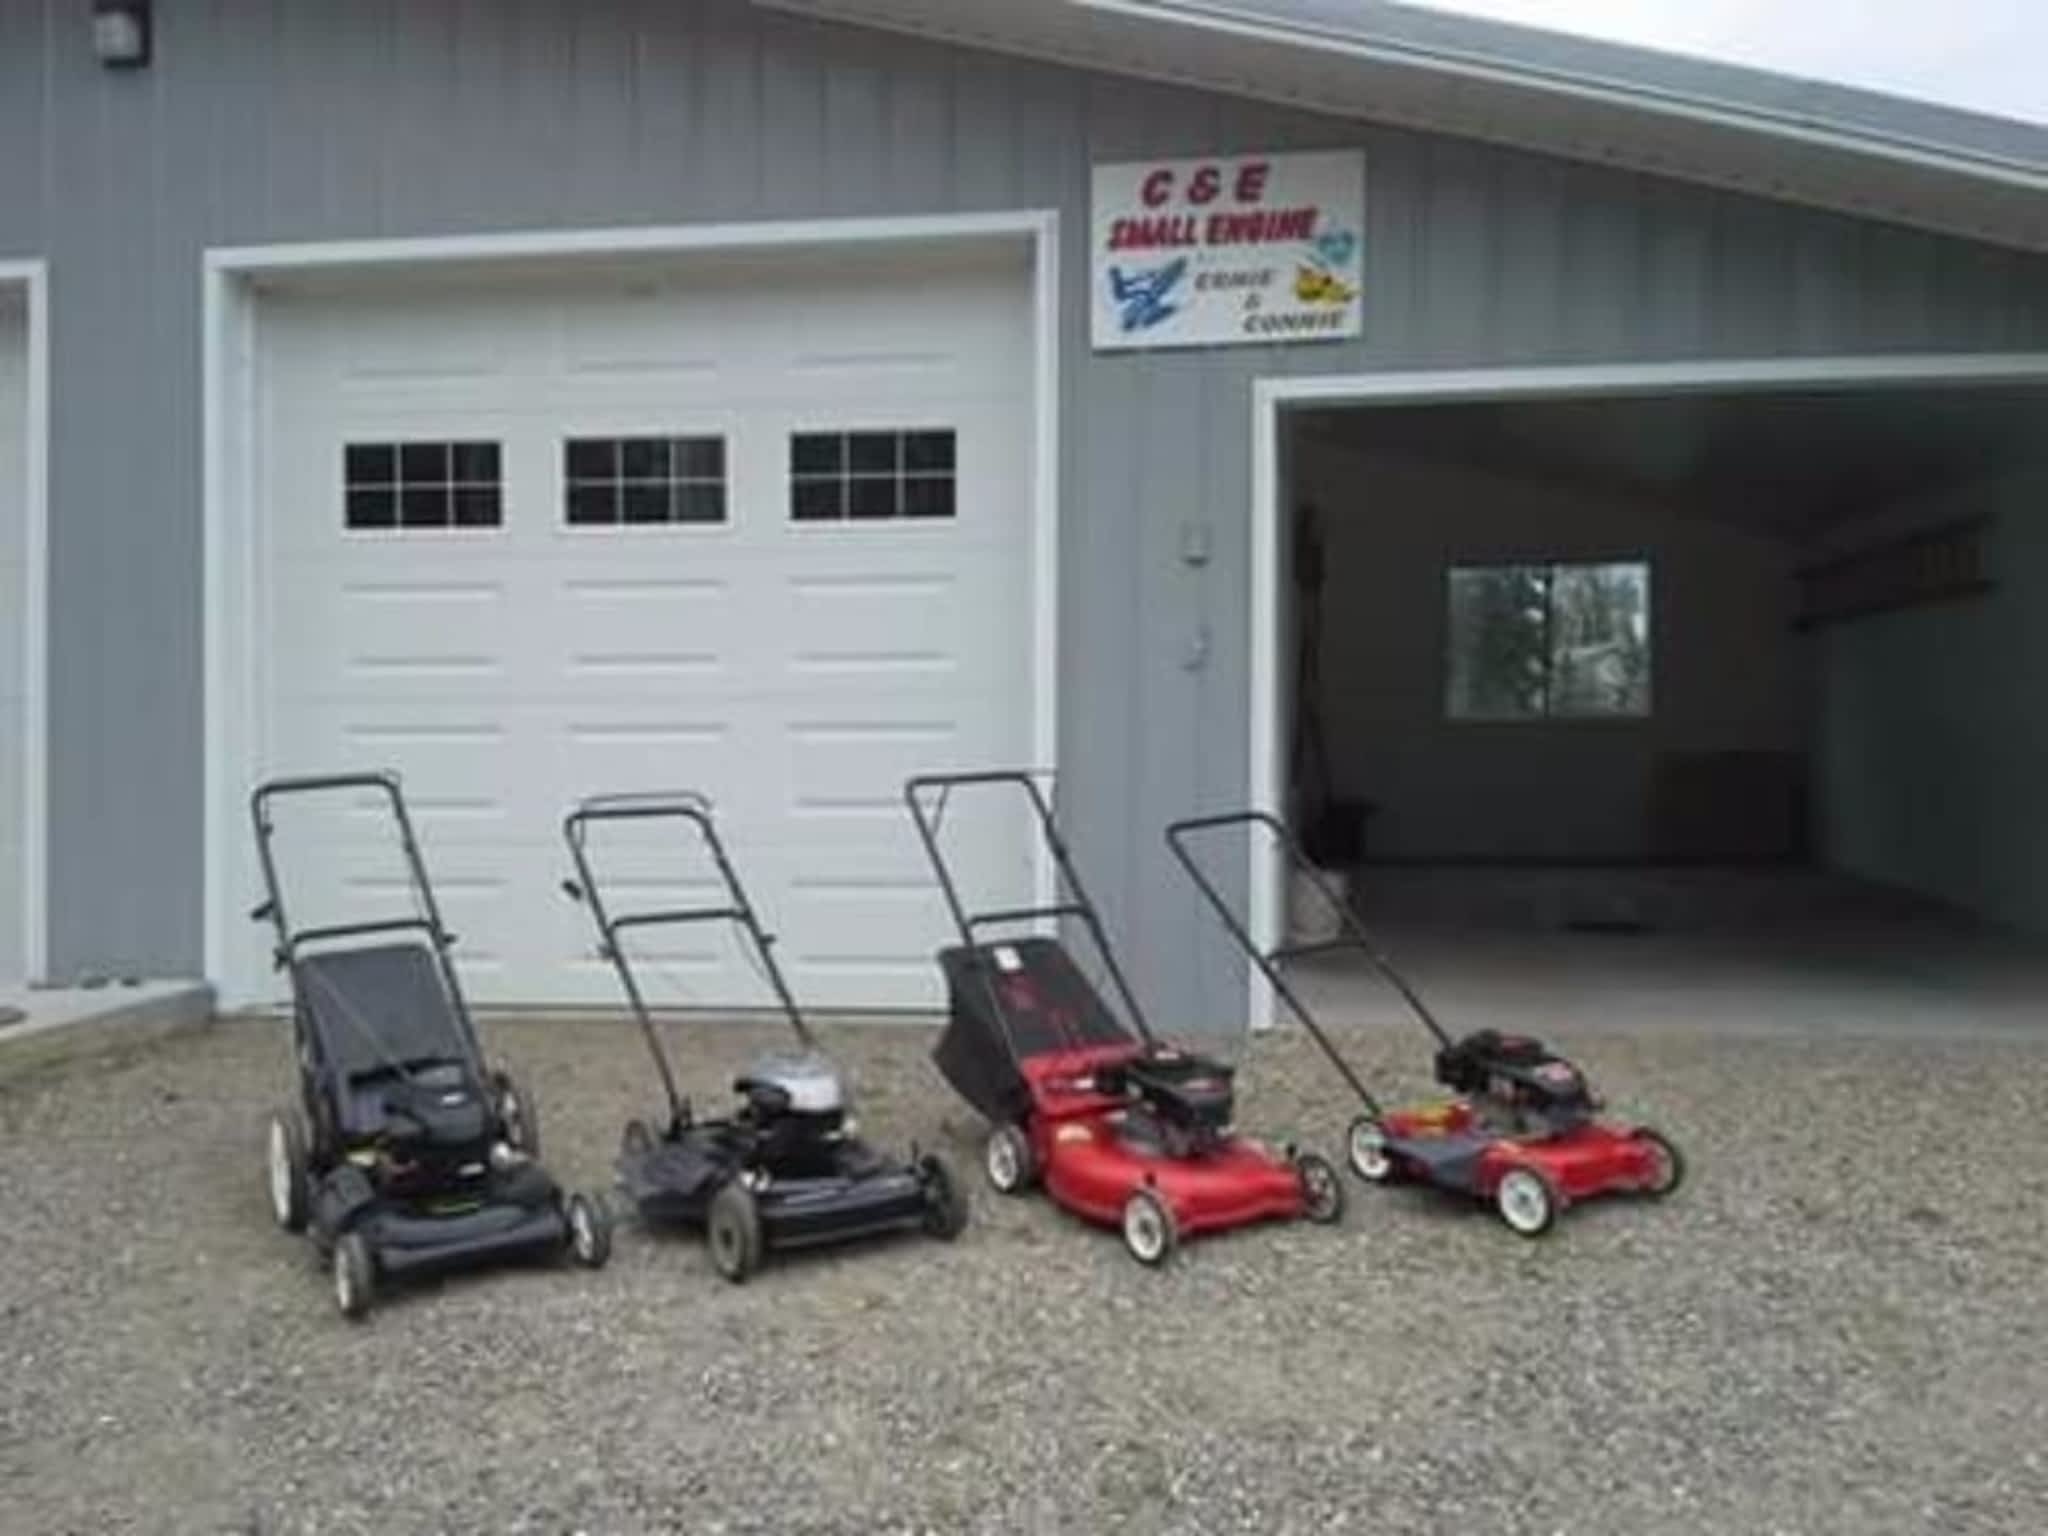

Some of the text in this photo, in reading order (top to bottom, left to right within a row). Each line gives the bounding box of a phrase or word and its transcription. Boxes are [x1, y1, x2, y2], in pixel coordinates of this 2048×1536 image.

[1142, 162, 1269, 207] C & E
[1108, 206, 1318, 250] SMALL ENGINE
